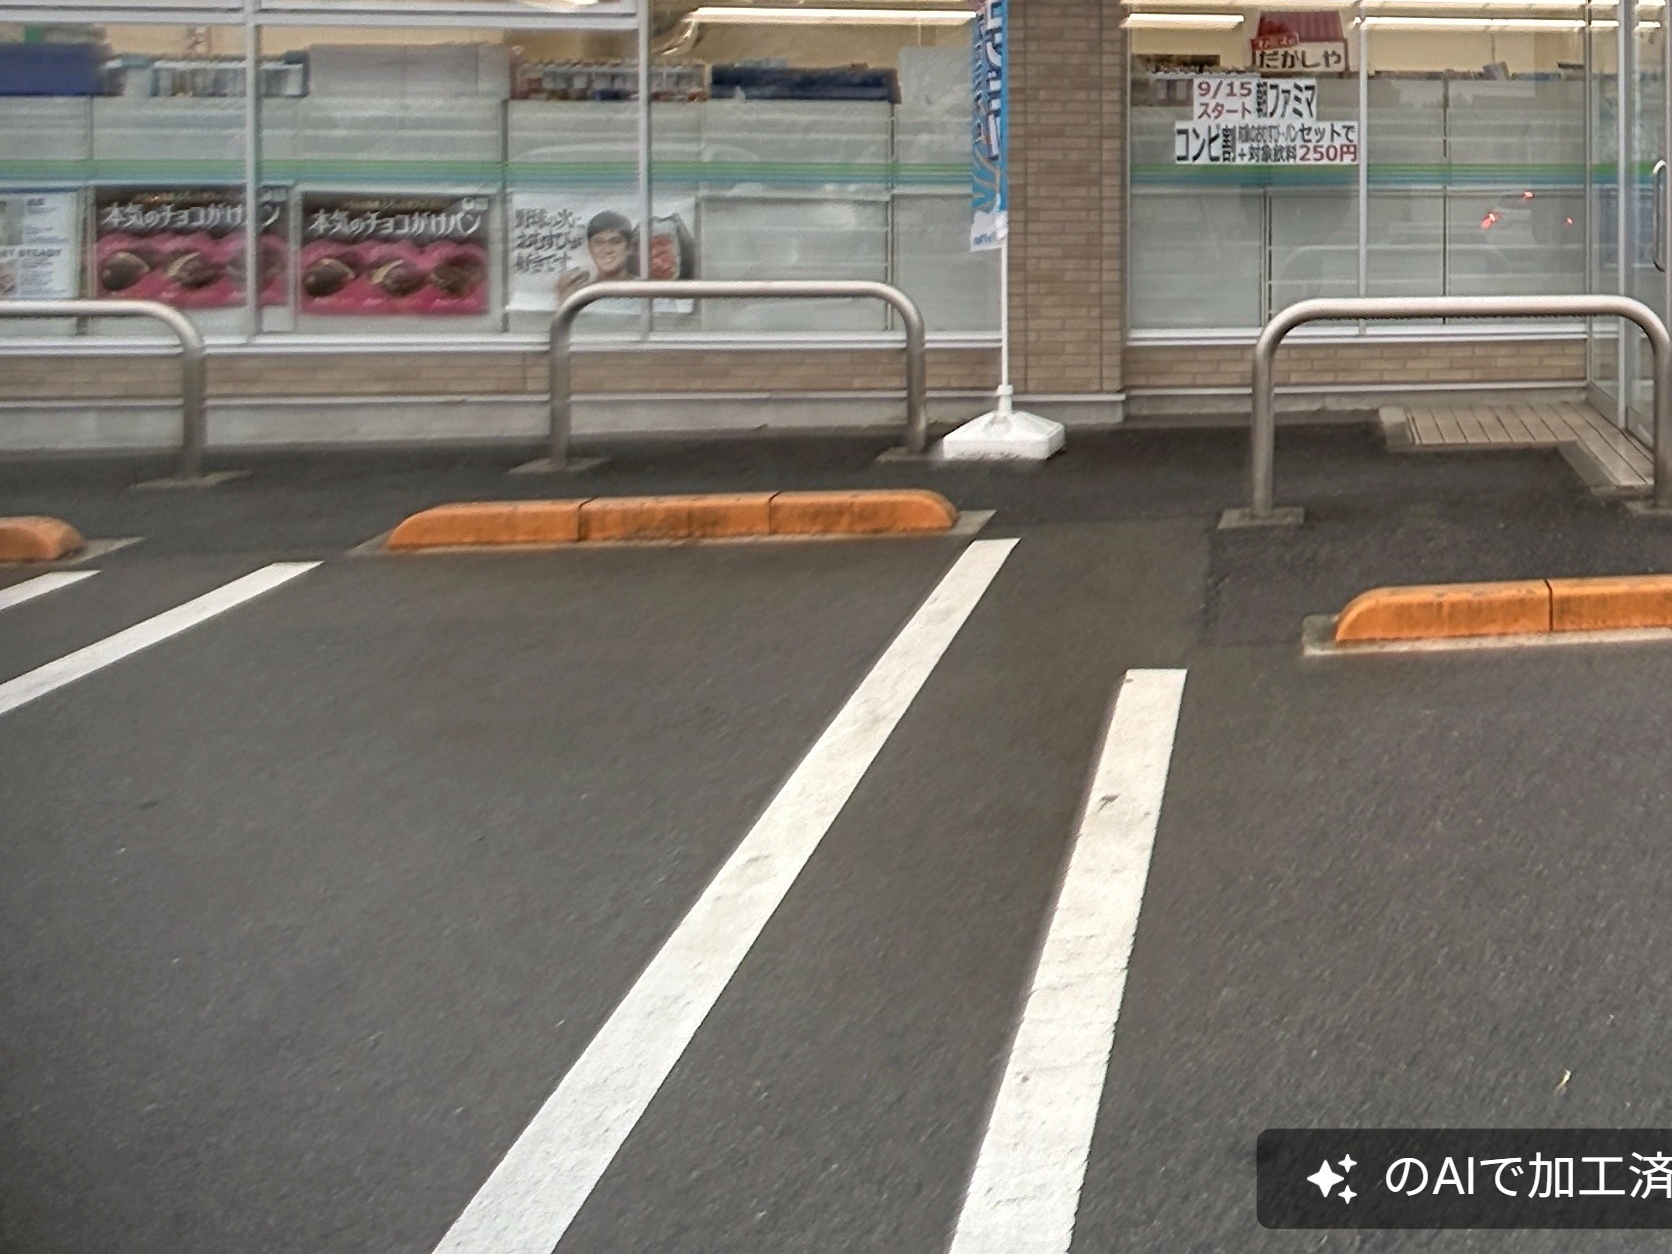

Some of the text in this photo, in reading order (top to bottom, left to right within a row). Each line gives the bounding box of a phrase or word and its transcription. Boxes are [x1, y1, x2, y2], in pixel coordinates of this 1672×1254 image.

[1197, 80, 1252, 99] 9/15
[1197, 101, 1252, 120] スタート
[1299, 144, 1357, 162] 250円
[102, 202, 280, 228] 本気のチョコがけン
